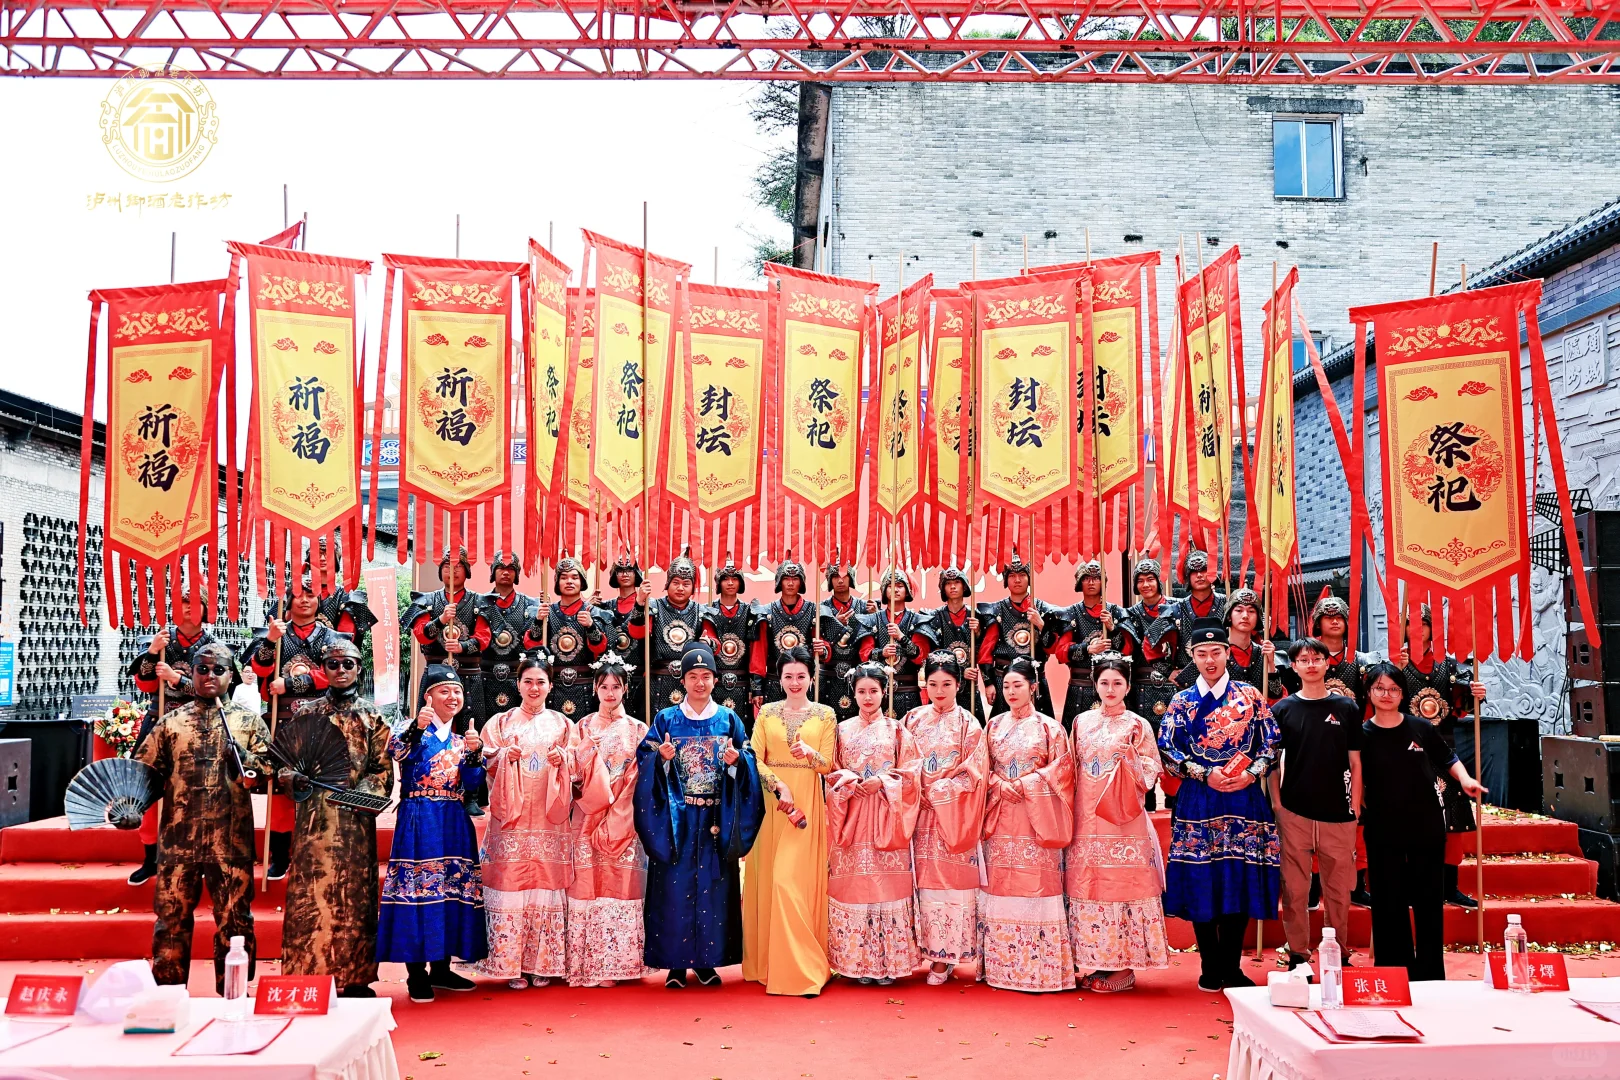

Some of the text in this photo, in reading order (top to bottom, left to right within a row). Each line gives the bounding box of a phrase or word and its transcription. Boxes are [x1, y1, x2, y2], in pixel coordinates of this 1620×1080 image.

[288, 376, 331, 465] 祈福
[435, 367, 477, 447] 祈福
[616, 360, 645, 440] 祭祀
[696, 384, 733, 457] 封坛
[806, 377, 840, 450] 祭祀
[1006, 377, 1043, 449] 封坛
[137, 403, 180, 492] 祈福
[1427, 421, 1482, 513] 祭祀
[19, 985, 69, 1003] 赵庆永
[267, 986, 319, 1003] 沈才洪
[1353, 977, 1389, 993] 张良
